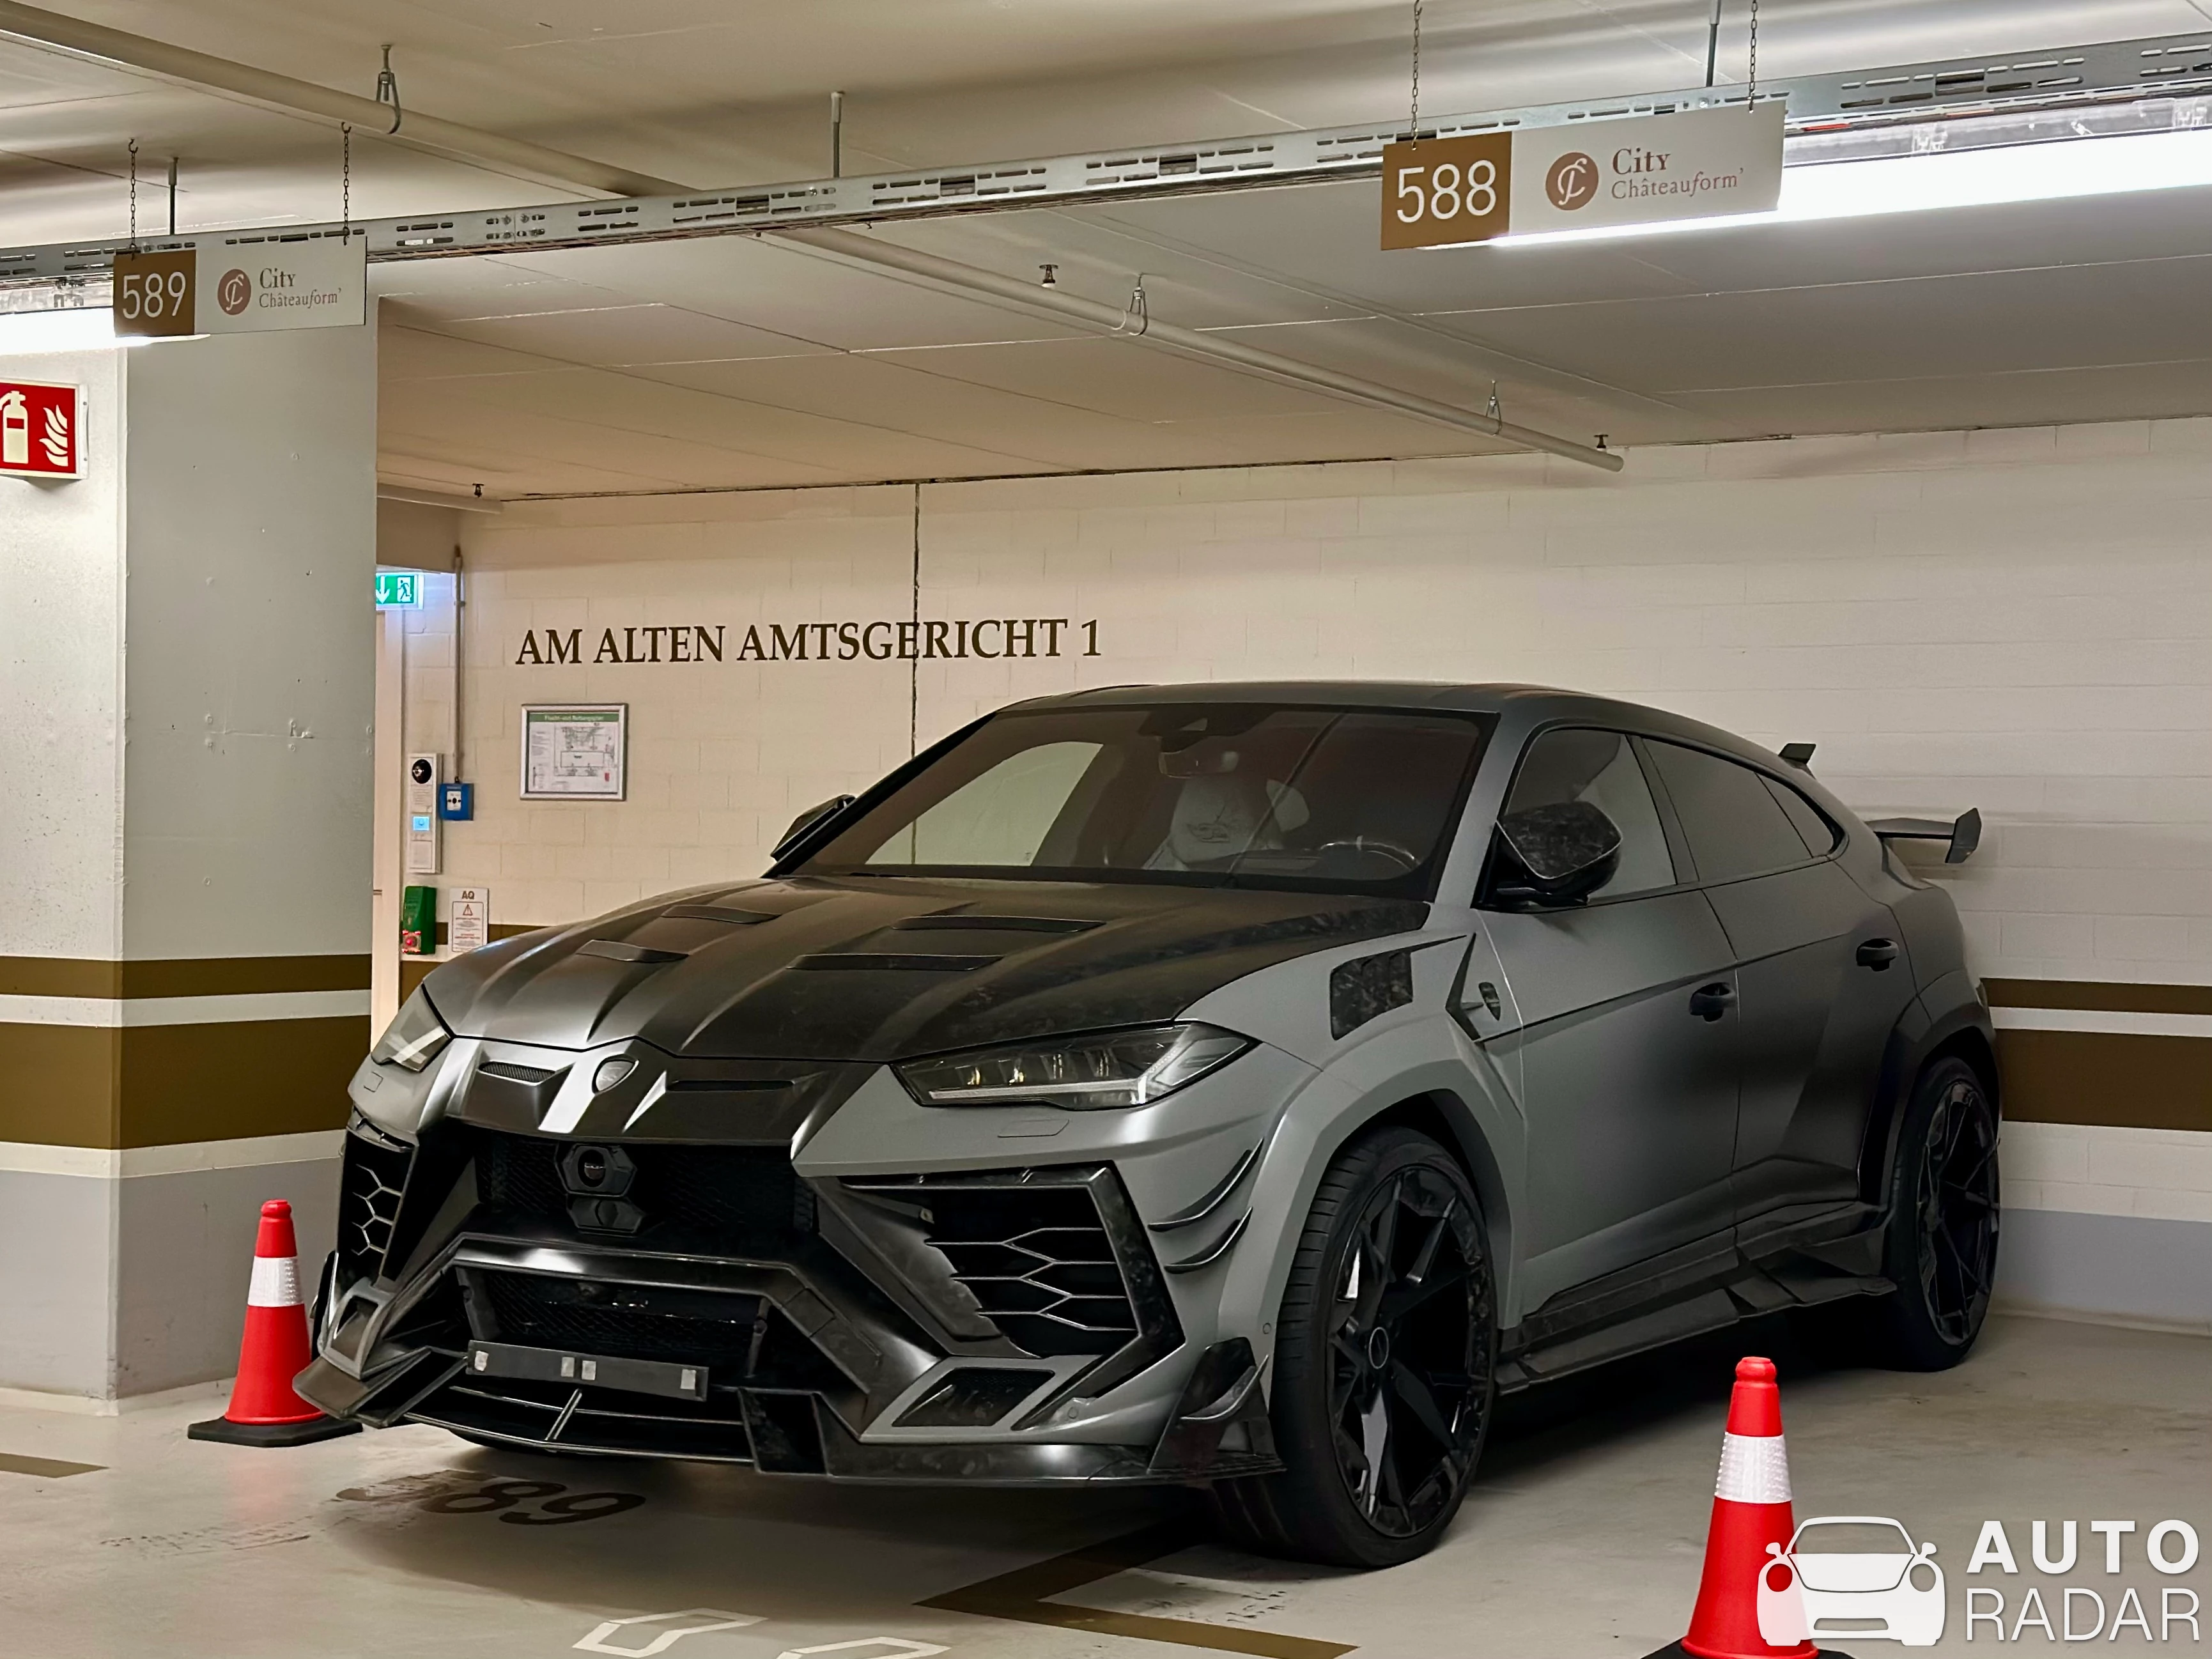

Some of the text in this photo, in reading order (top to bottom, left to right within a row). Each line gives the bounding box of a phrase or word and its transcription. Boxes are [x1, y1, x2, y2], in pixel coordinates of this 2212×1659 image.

[1396, 160, 1496, 223] 588
[123, 272, 186, 319] 589
[515, 619, 1101, 665] AM ALTEN AMTSGERICHT 1
